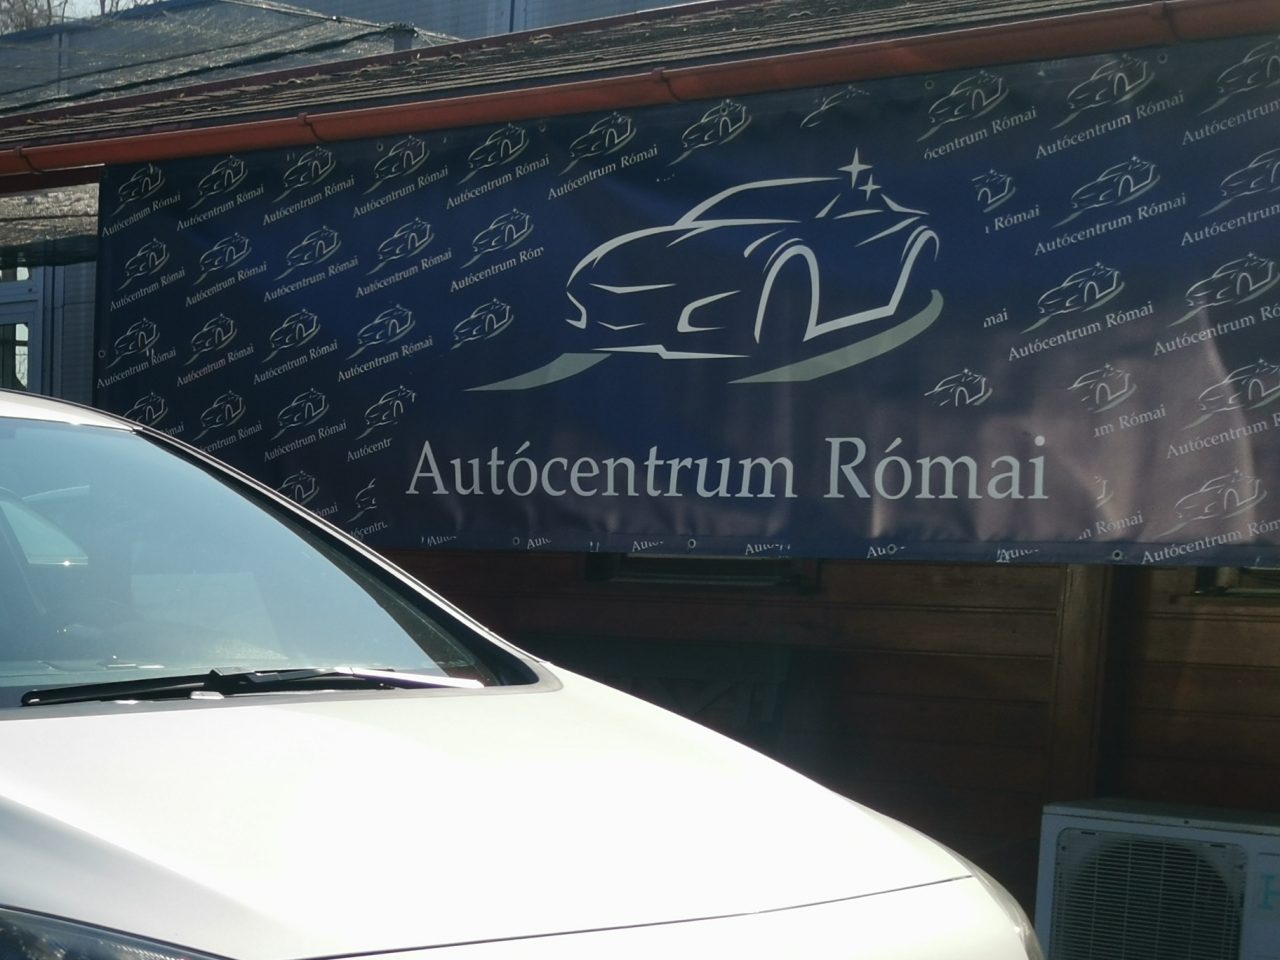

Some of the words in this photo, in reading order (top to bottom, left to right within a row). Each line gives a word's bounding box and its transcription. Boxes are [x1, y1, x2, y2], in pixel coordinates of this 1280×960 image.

[992, 106, 1037, 135] Római
[1036, 113, 1131, 159] Autócentrum
[1135, 90, 1184, 120] Római
[353, 184, 415, 218] Autócentrum
[417, 165, 449, 188] Római
[446, 174, 512, 210] Autócentrum
[515, 153, 550, 178] Római
[548, 163, 616, 200] Autócentrum
[621, 144, 658, 169] Római
[101, 207, 151, 238] Autócentrum
[152, 192, 181, 211] Római
[176, 202, 234, 231] Autócentrum
[236, 184, 264, 205] Római
[262, 192, 322, 226] Autócentrum
[324, 174, 355, 197] Római
[993, 204, 1040, 231] Római
[1034, 214, 1132, 256] Autócentrum
[1137, 193, 1186, 220] Római
[110, 282, 159, 312] Autócentrum
[160, 266, 186, 287] Római
[185, 277, 236, 307] Autócentrum
[237, 261, 267, 281] Római
[263, 273, 325, 302] Autócentrum
[328, 256, 358, 277] Római
[355, 263, 418, 298] Autócentrum
[420, 248, 452, 270] Római
[450, 257, 517, 293] Autócentrum
[1008, 321, 1101, 361] Autócentrum
[1105, 301, 1154, 328] Római
[1153, 315, 1255, 356] Autócentrum
[96, 361, 149, 389] Autócentrum
[151, 346, 177, 366] Római
[176, 359, 226, 387] Autócentrum
[227, 343, 254, 363] Római
[253, 354, 308, 385] Autócentrum
[309, 339, 338, 360] Római
[338, 350, 399, 382] Autócentrum
[401, 335, 433, 357] Római
[238, 420, 263, 440] Római
[1119, 404, 1167, 429] Római
[1166, 420, 1268, 459] Autócentrum
[264, 433, 316, 462] Autócentrum
[317, 418, 347, 439] Római
[406, 440, 797, 499] Autócentrum
[824, 434, 1049, 500] Római
[1095, 510, 1144, 535] Római
[1141, 530, 1243, 565] Autócentrum
